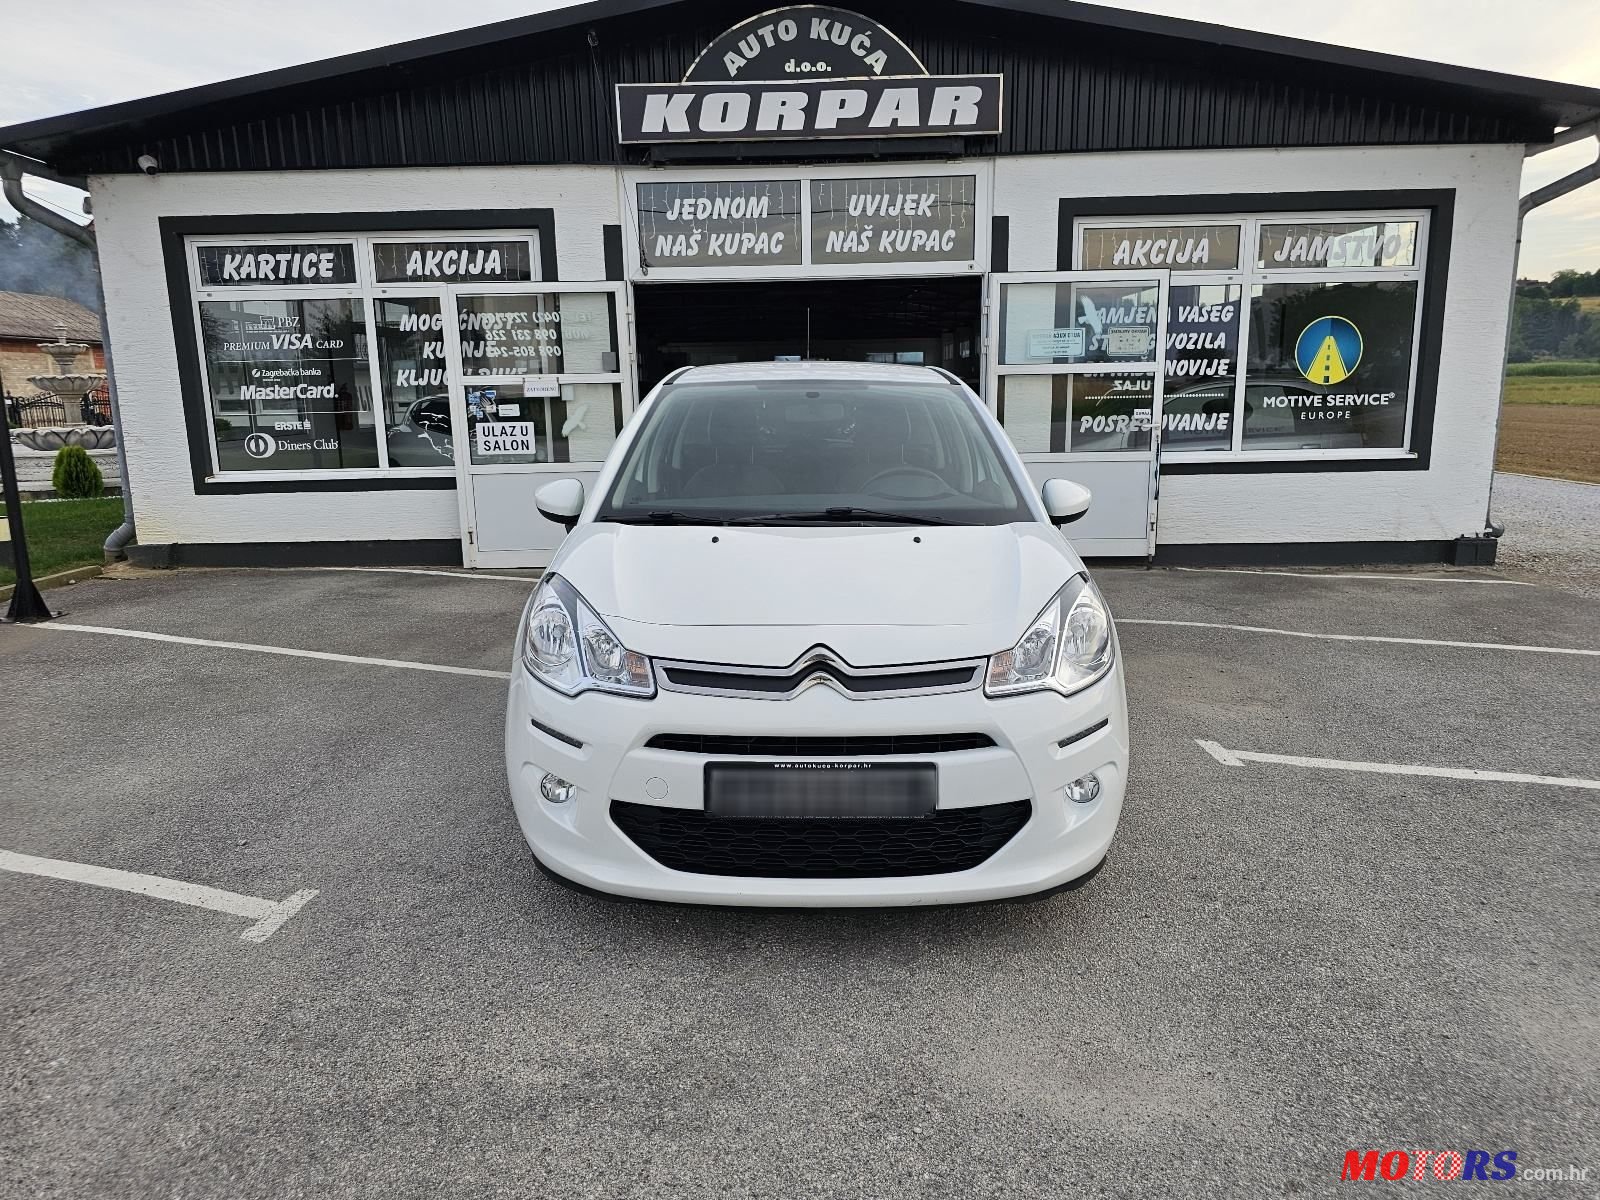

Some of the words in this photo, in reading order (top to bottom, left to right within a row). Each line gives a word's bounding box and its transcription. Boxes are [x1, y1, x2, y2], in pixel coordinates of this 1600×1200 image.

[722, 19, 798, 77] AUTO
[809, 17, 888, 76] KUĆA
[784, 59, 832, 73] d.o.o.
[641, 85, 983, 133] KORPAR
[666, 196, 769, 221] JEDNOM
[849, 193, 937, 217] UVIJEK
[655, 225, 700, 257] NAŠ
[708, 231, 785, 256] KUPAC
[825, 225, 874, 253] NAŠ
[878, 229, 956, 253] KUPAC
[1273, 234, 1402, 262] JAMSTVO
[1112, 238, 1210, 267] AKCIJA
[223, 252, 335, 281] KARTICE
[406, 249, 502, 277] AKCIJA
[278, 316, 301, 328] PBZ
[223, 342, 270, 351] PREMIUM
[270, 333, 313, 350] VISA
[316, 340, 344, 349] CARD
[1166, 331, 1226, 350] VOZILA
[422, 341, 497, 360] KUNJE
[300, 368, 322, 376] banka
[1164, 358, 1230, 377] NOVIJE
[1262, 395, 1323, 408] MOTIVE
[1300, 410, 1351, 420] EUROPE
[274, 421, 303, 430] ERSTE
[482, 425, 517, 437] ULAZ
[520, 425, 529, 437] U
[278, 440, 312, 451] Diners
[313, 438, 338, 450] Club
[483, 439, 530, 451] SALON
